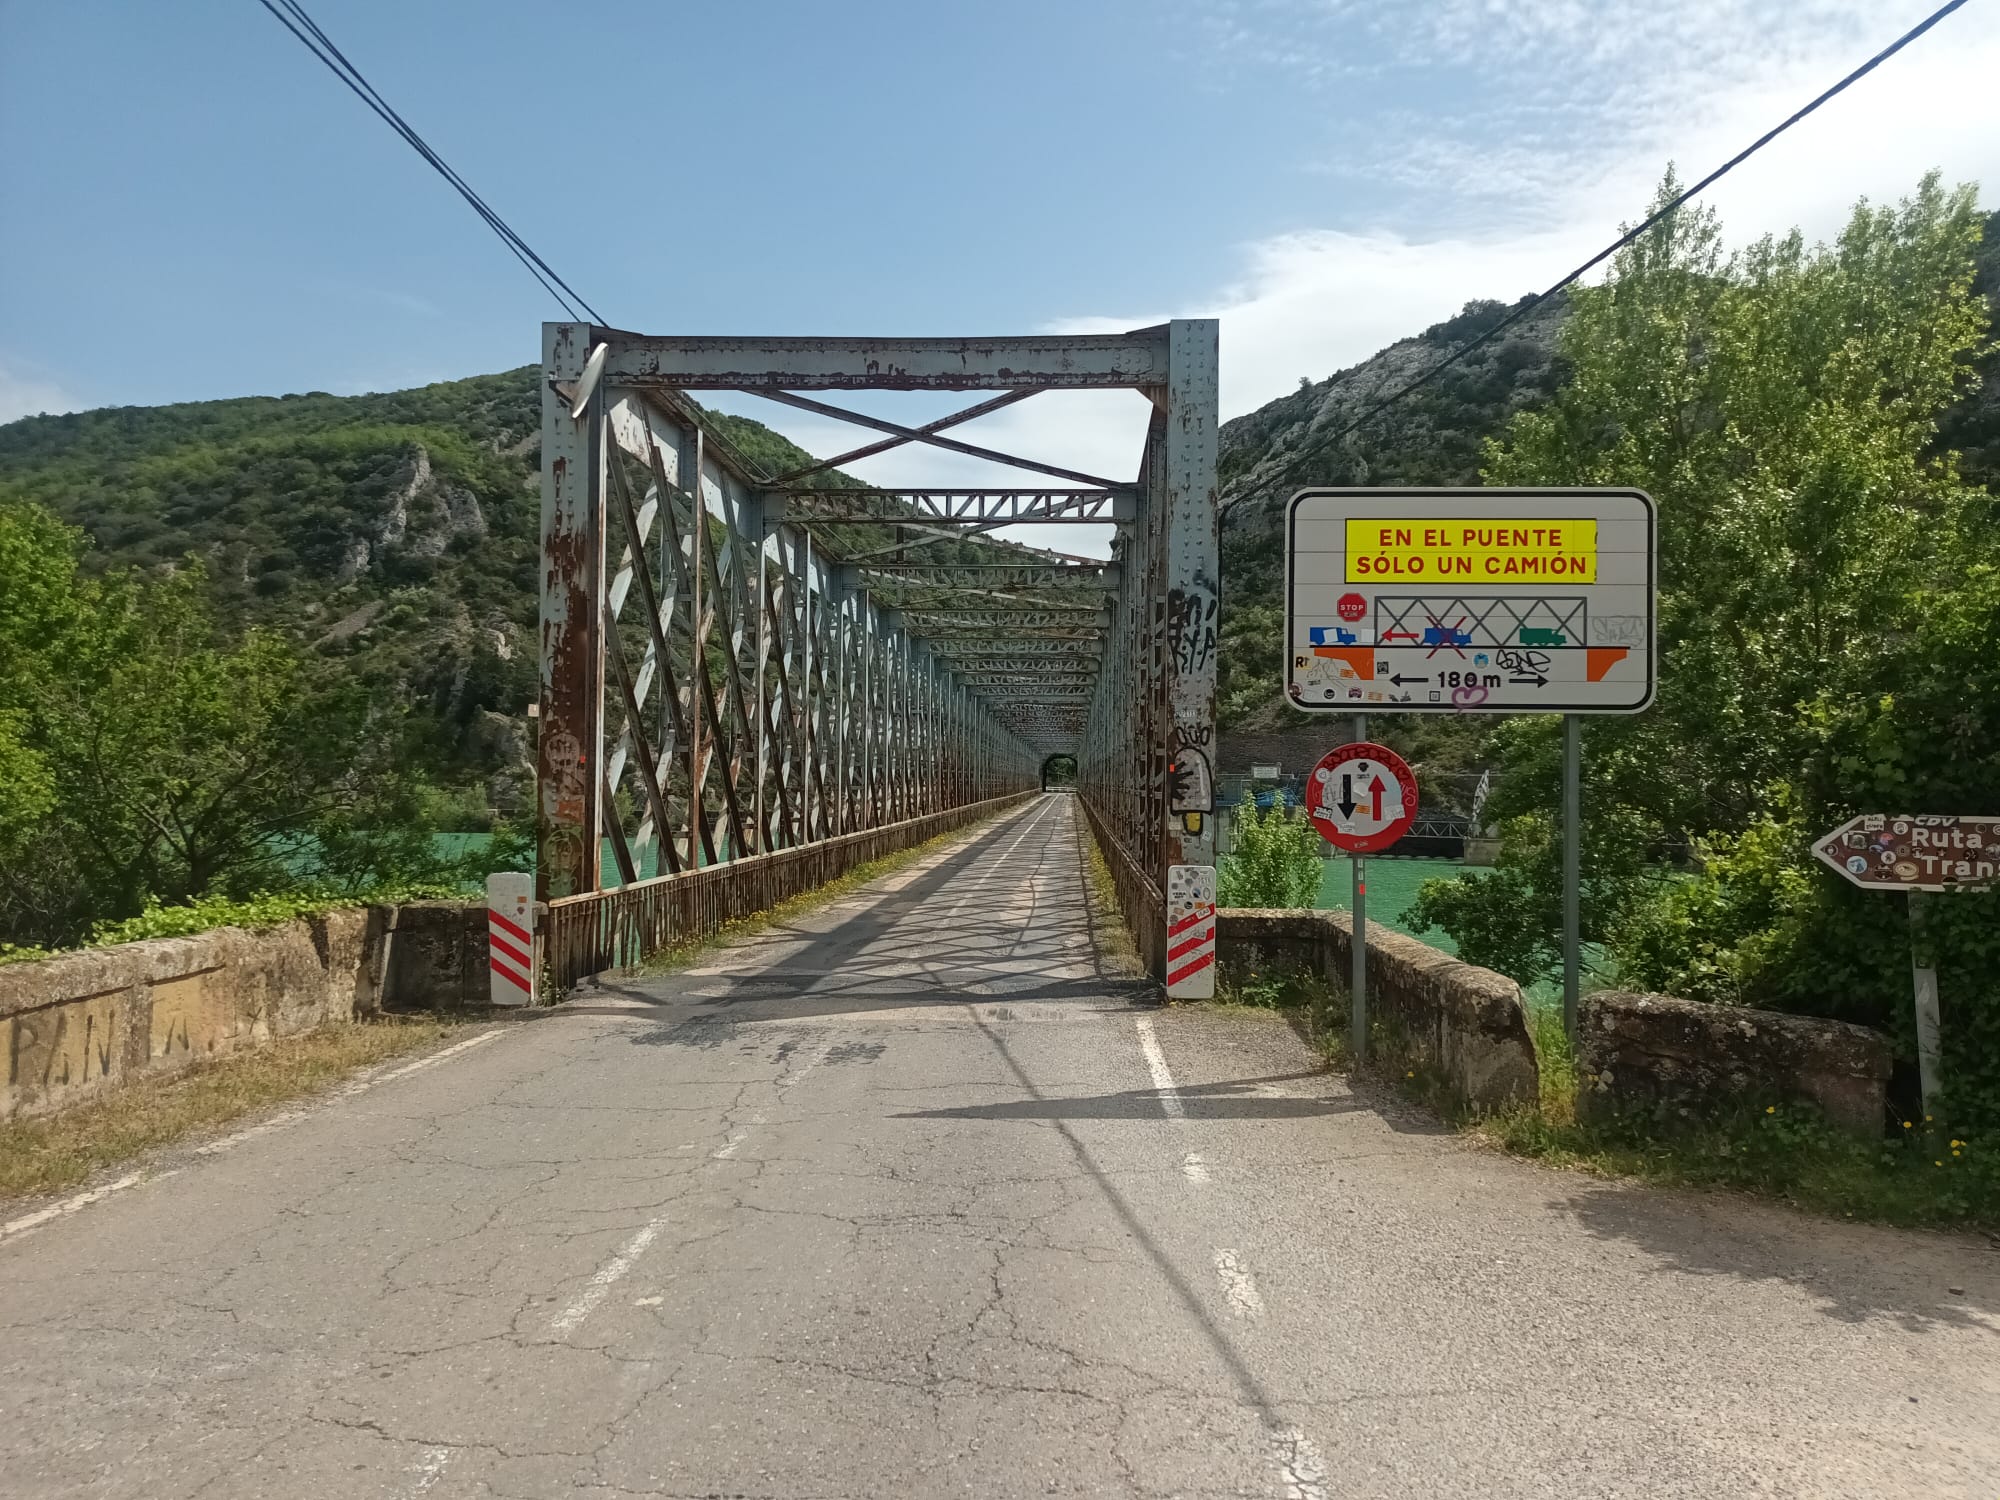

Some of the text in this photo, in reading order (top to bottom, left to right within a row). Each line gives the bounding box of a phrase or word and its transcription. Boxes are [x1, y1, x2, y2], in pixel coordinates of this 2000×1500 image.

[1379, 529, 1563, 547] EN EL PUENTE
[1356, 551, 1587, 575] SÓLO UN CAMIÓN
[1914, 816, 1958, 827] CDV
[1911, 827, 1983, 849] Ruta
